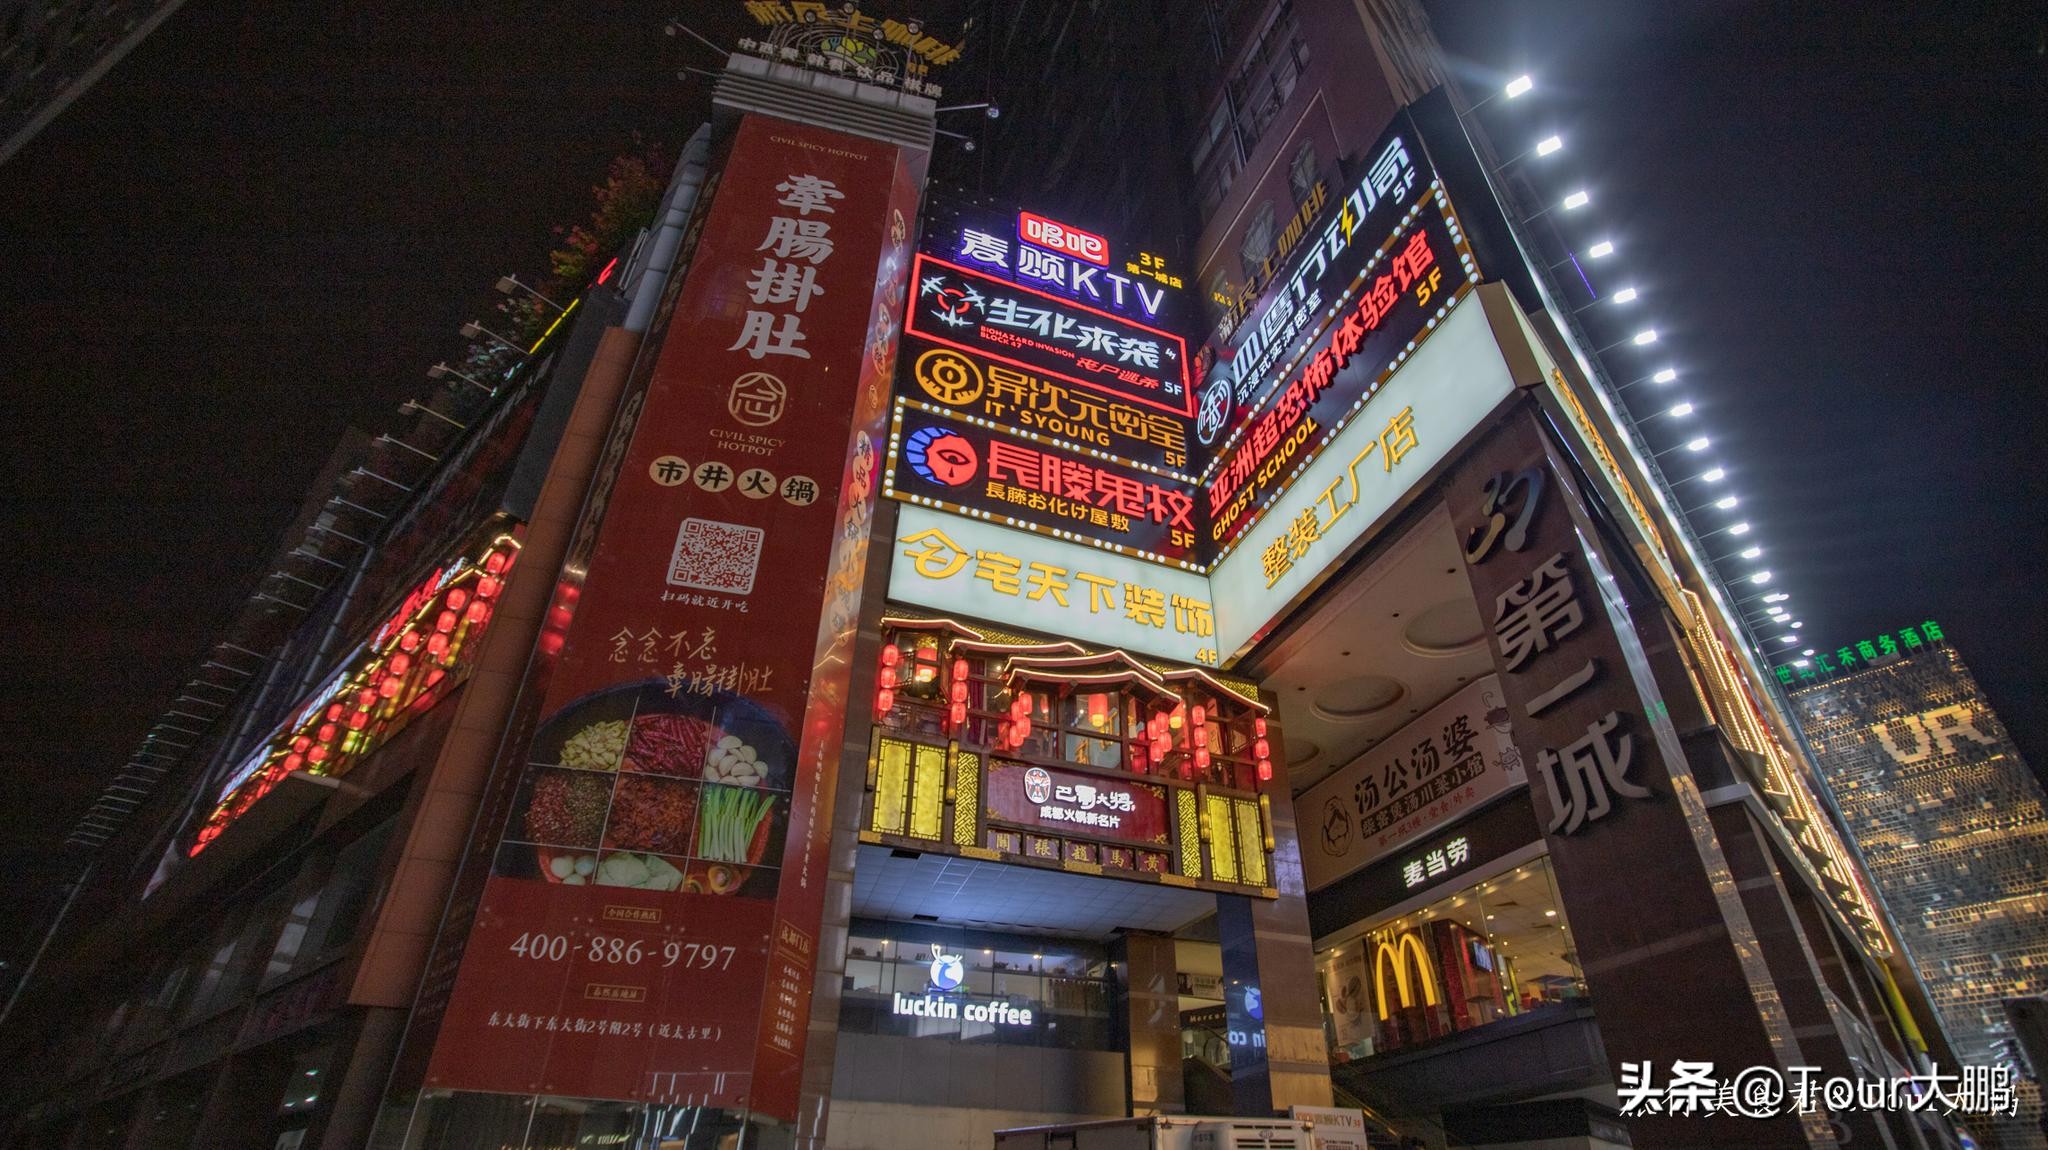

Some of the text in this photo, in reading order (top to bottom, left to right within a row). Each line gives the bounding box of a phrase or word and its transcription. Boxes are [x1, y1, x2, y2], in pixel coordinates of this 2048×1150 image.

[770, 135, 870, 161] CIVIL SPICY HOTPOT
[1392, 166, 1417, 205] 5F
[1027, 219, 1103, 261] 唱吧
[1126, 261, 1184, 290] 第一城店
[1139, 252, 1165, 270] 3F
[1414, 266, 1442, 307] 5F
[980, 332, 1022, 349] BLOCK 47
[980, 325, 1076, 359] BIOHAZARD INVASION
[986, 298, 1159, 369] 生化来袭
[1164, 381, 1183, 397] 5F
[1208, 228, 1435, 519] 亚洲超恐怖体验馆
[709, 428, 787, 448] CIVIL SPICY
[717, 440, 775, 457] HOTPOT
[1163, 451, 1187, 468] 5F
[1212, 416, 1318, 541] GHOST SCHOOL
[985, 481, 1131, 533] 長藤お化け屋敷
[1261, 405, 1420, 590] 整装工厂店
[1171, 529, 1195, 549] 5F
[660, 589, 750, 613] 扫码就近开吃
[974, 550, 1214, 638] 宅天下装饰
[608, 626, 717, 663] 念念不忘
[1195, 648, 1217, 665] 4F
[1354, 713, 1479, 814] 汤公汤婆
[1040, 805, 1121, 829] 成都火锅新名片
[1403, 836, 1470, 889] 麦当劳
[510, 931, 737, 971] 400-886-9797
[893, 992, 1033, 1026] luckin coffee
